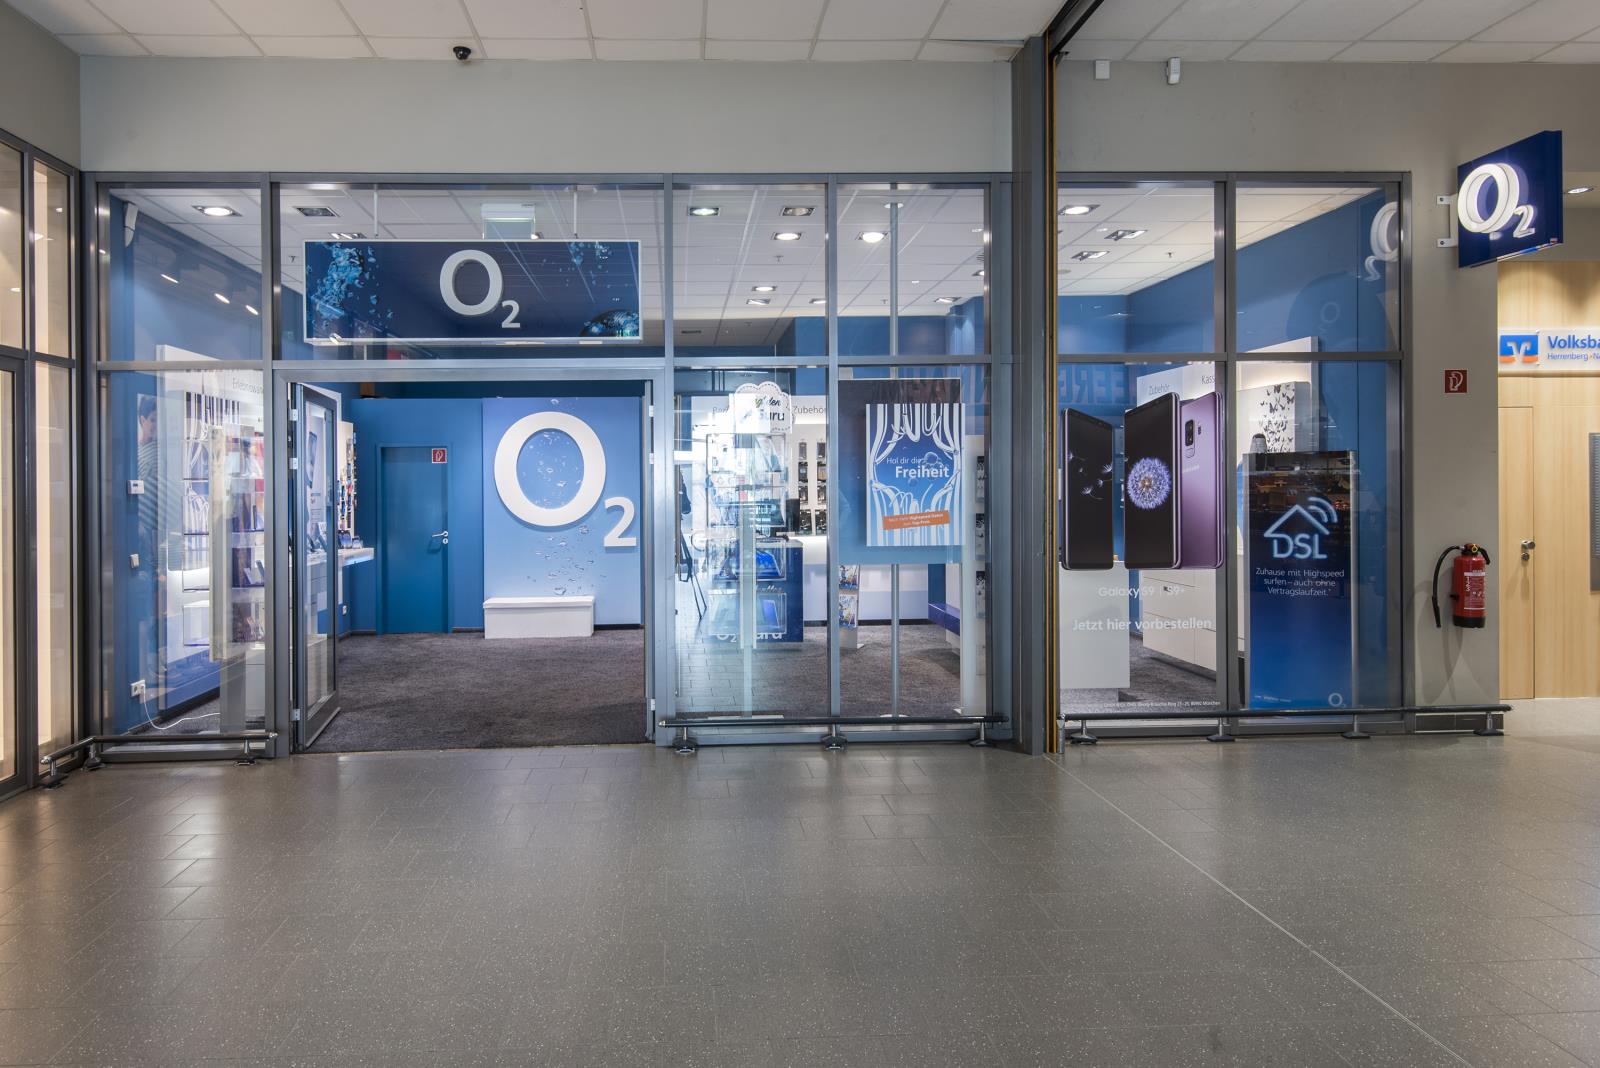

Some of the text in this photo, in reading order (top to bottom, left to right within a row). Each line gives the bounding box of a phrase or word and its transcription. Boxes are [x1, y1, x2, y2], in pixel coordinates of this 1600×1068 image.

[895, 465, 950, 479] Freiheit
[1272, 533, 1328, 559] DSL
[1255, 567, 1345, 579] Zuhause mit Highspeed
[1264, 577, 1287, 585] surfen
[1293, 579, 1313, 587] auch
[1315, 579, 1336, 587] ohne
[1098, 586, 1139, 599] Galaxy
[1072, 617, 1212, 631] Jetzt hier vorbestellen
